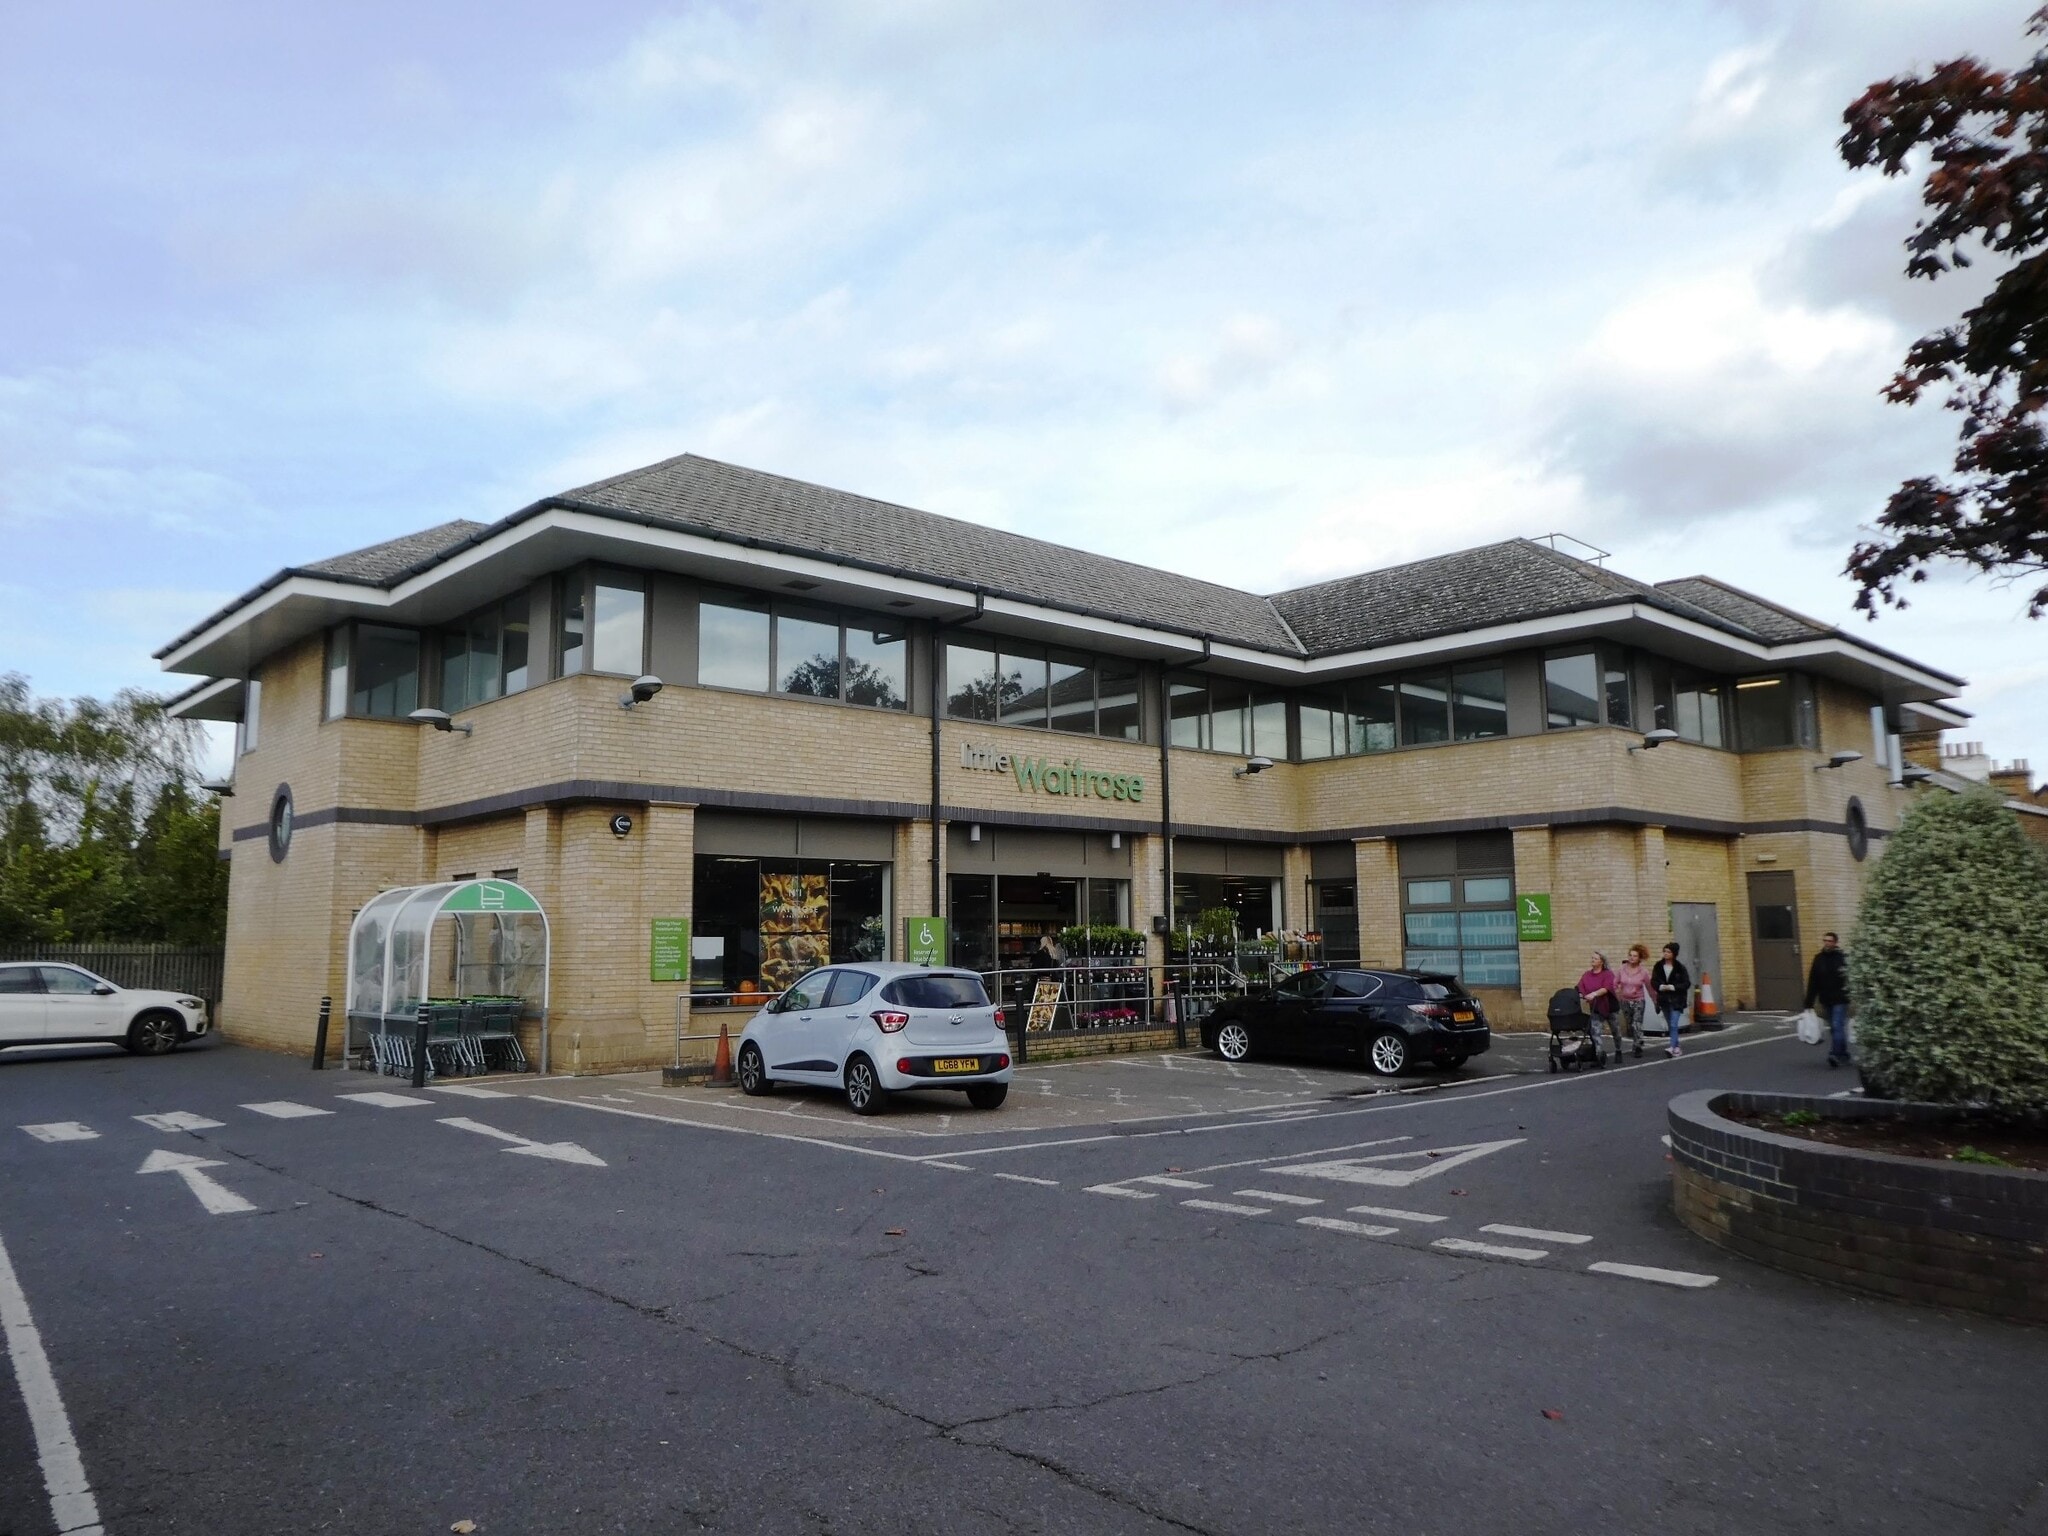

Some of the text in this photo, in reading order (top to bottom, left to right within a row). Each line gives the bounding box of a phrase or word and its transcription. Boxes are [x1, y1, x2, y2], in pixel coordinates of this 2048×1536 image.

[960, 741, 1145, 802] little Waitrose
[772, 904, 819, 914] WAIROSE
[938, 1059, 976, 1070] LG68 YFM
